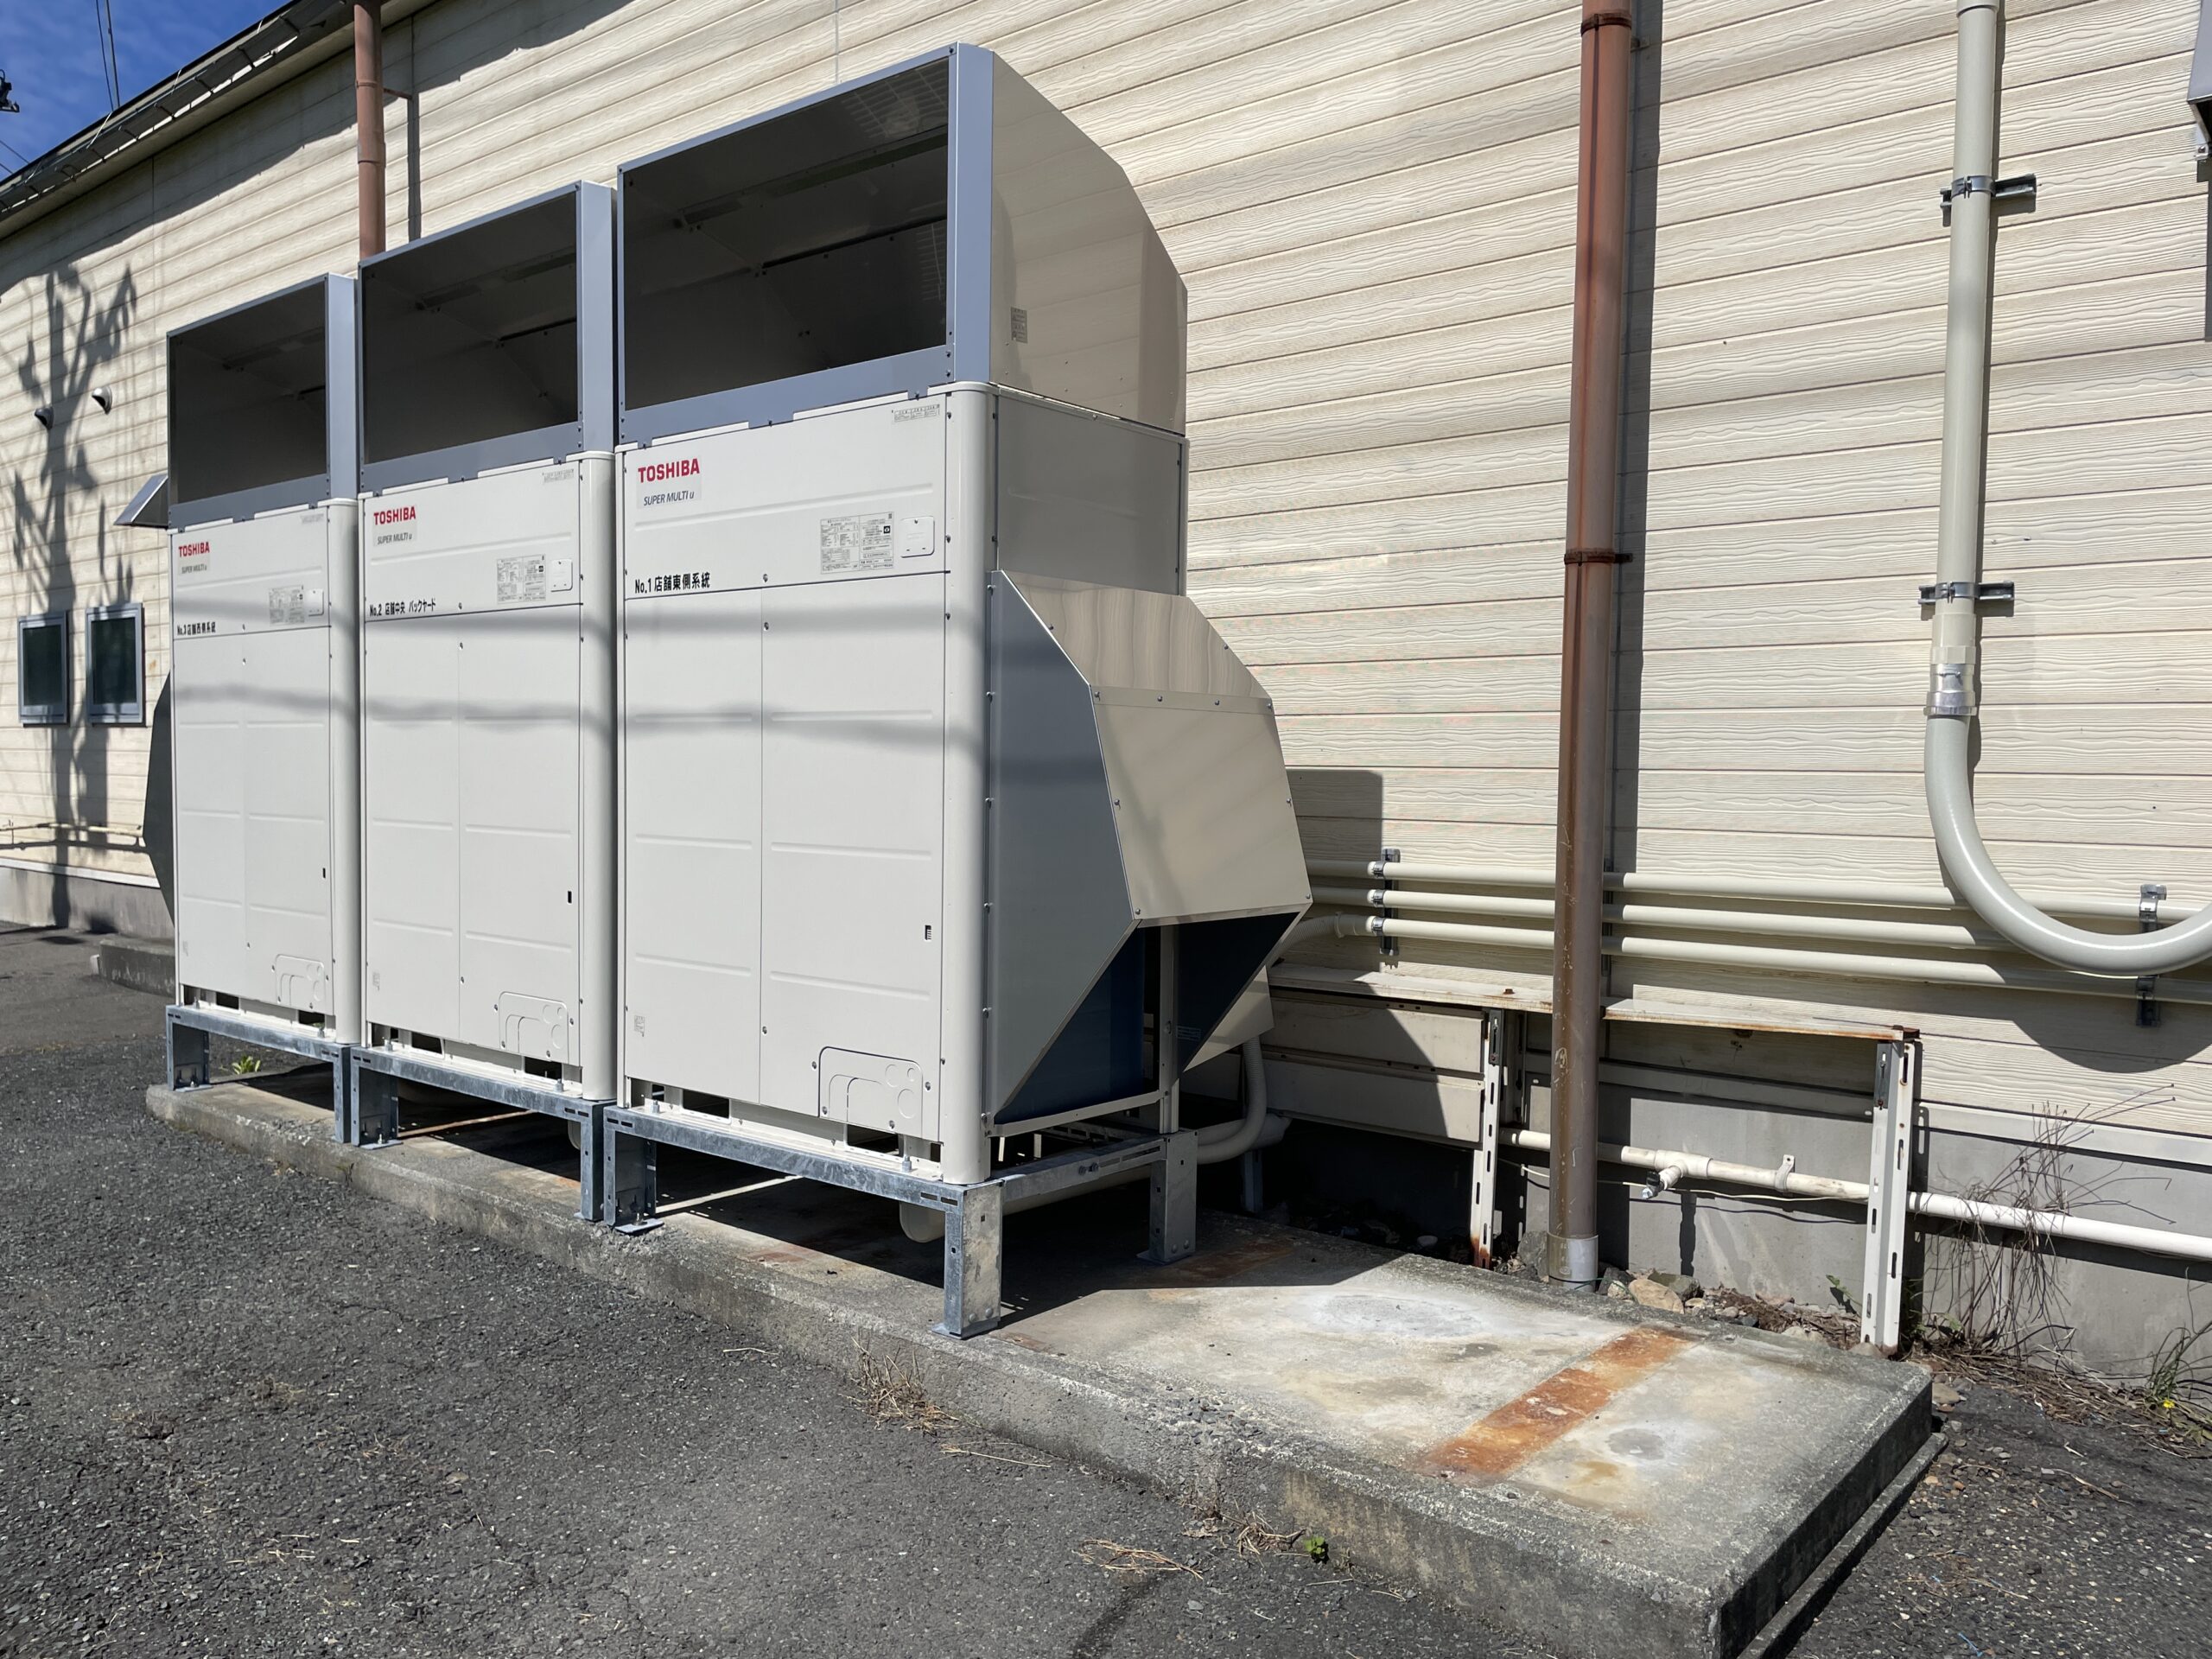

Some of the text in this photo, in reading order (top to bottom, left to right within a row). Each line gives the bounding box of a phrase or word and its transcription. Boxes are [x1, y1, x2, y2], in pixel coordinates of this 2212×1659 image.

[638, 458, 700, 483] TOSHIBA
[644, 493, 665, 505] SUPER
[666, 490, 689, 503] MULTI
[373, 505, 416, 525] TOSHIBA
[378, 534, 392, 544] SUPER
[393, 532, 408, 542] MULTI
[178, 541, 210, 557] TOSHIBA
